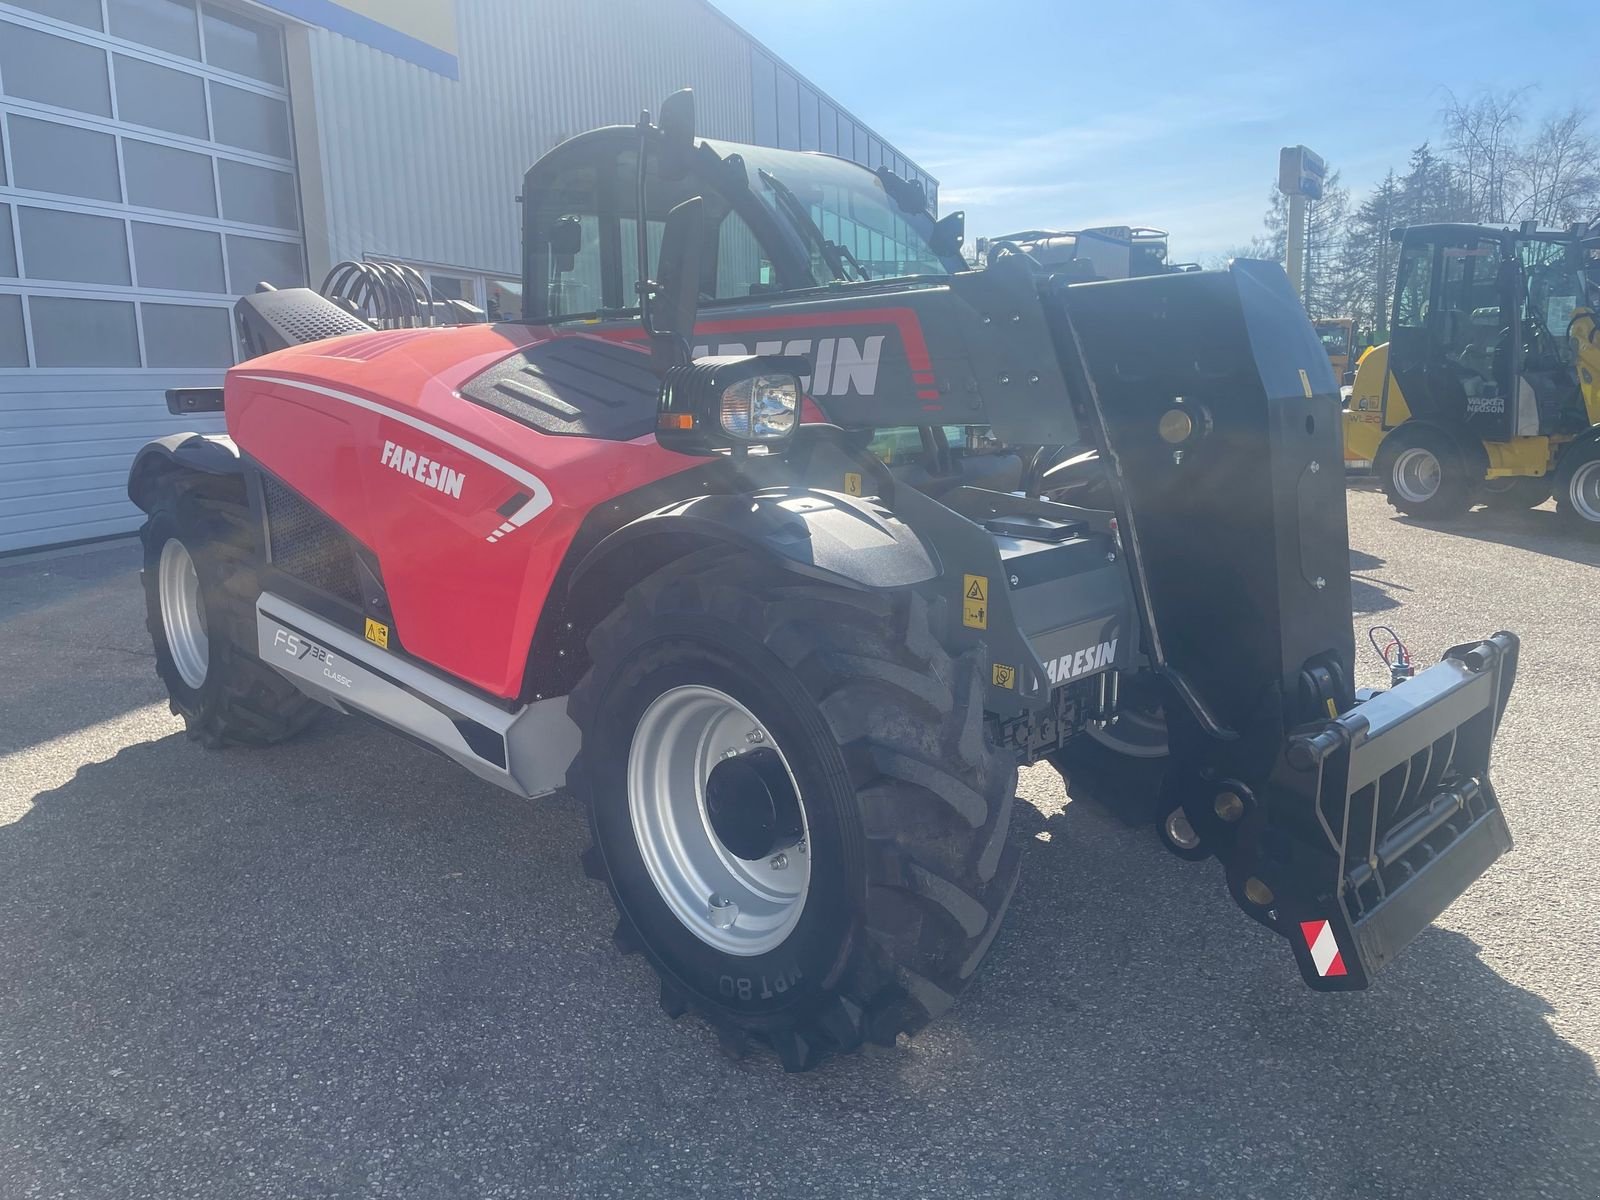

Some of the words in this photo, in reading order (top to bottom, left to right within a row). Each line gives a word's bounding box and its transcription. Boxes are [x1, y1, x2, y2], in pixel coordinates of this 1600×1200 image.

[380, 440, 466, 500] FARESIN
[323, 668, 353, 688] CLASSIC
[720, 974, 753, 1001] 80
